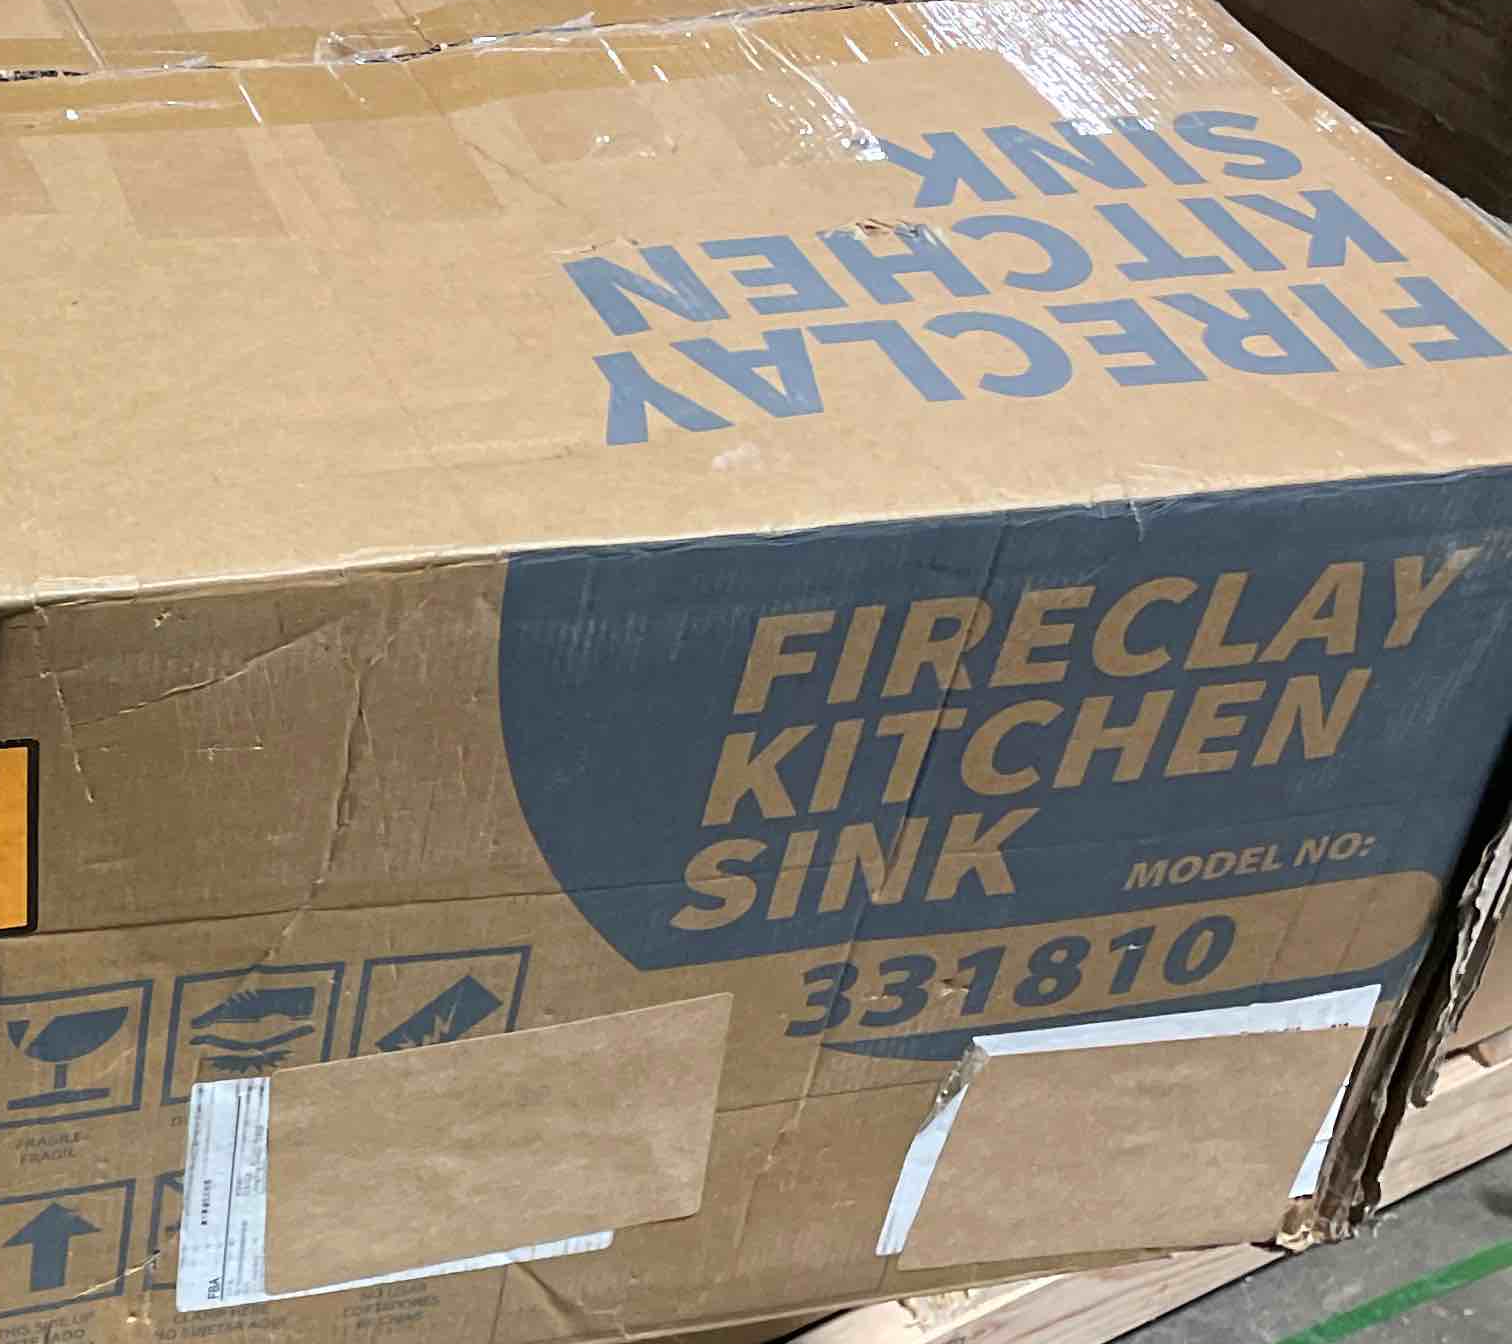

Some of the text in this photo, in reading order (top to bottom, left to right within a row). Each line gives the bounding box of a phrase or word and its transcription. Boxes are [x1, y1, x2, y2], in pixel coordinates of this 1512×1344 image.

[882, 109, 1303, 208] SINK
[561, 189, 1408, 336] KITCHEN
[593, 275, 1509, 446] FIRECLAY
[732, 547, 1482, 716] FIRECLAY
[701, 666, 1374, 828] KITCHEN
[669, 807, 1041, 932] SINK
[1120, 831, 1378, 892] MODEL NO:
[784, 913, 1238, 1038] 331810
